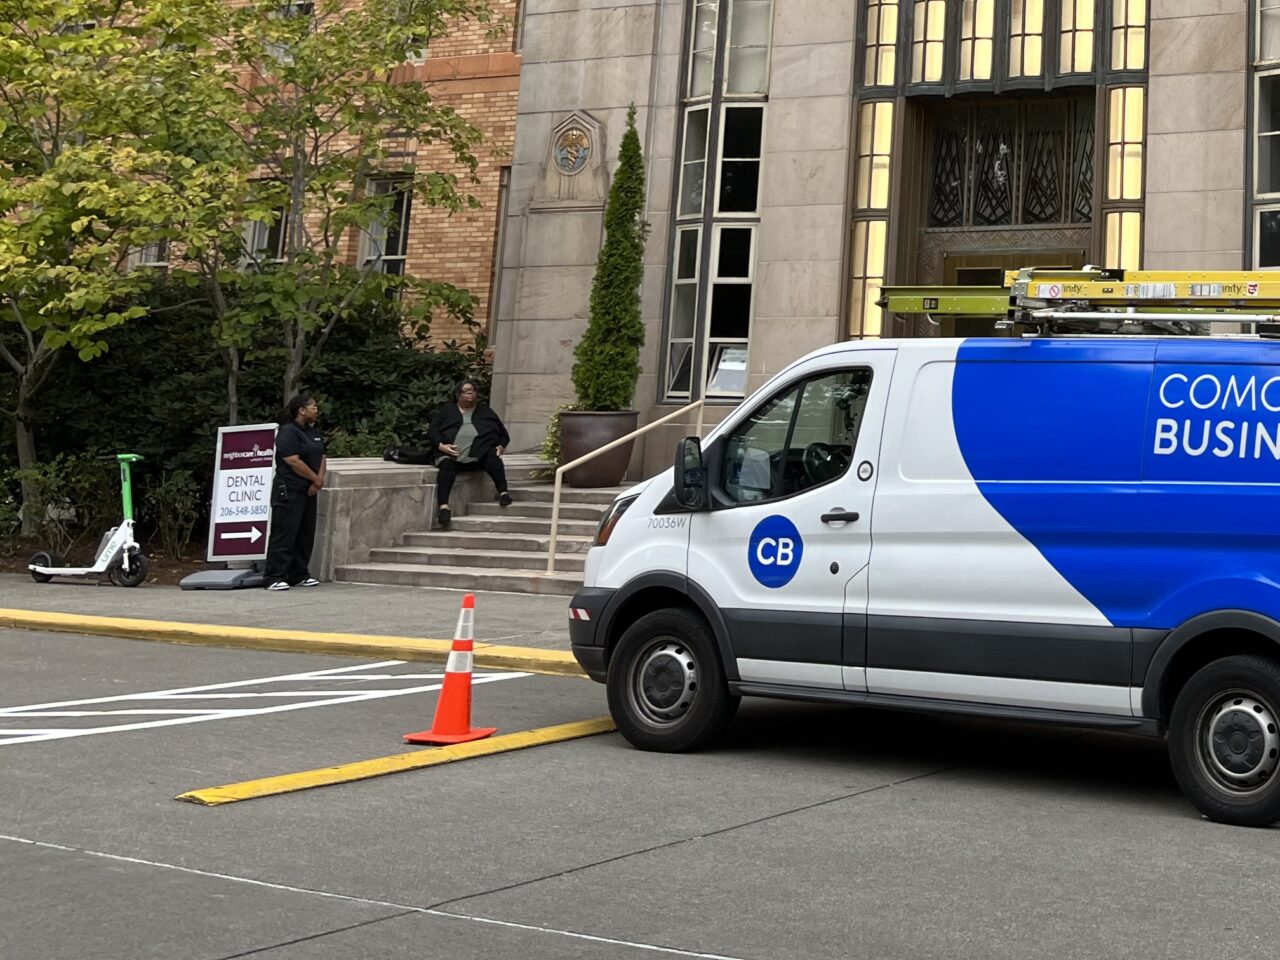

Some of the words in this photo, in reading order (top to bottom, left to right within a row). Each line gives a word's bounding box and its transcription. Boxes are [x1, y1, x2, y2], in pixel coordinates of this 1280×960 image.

[226, 474, 265, 488] DENTAL
[228, 489, 262, 503] CLINIC
[220, 504, 268, 517] 206-548-5850
[647, 517, 687, 529] 70036W
[756, 537, 794, 566] CB
